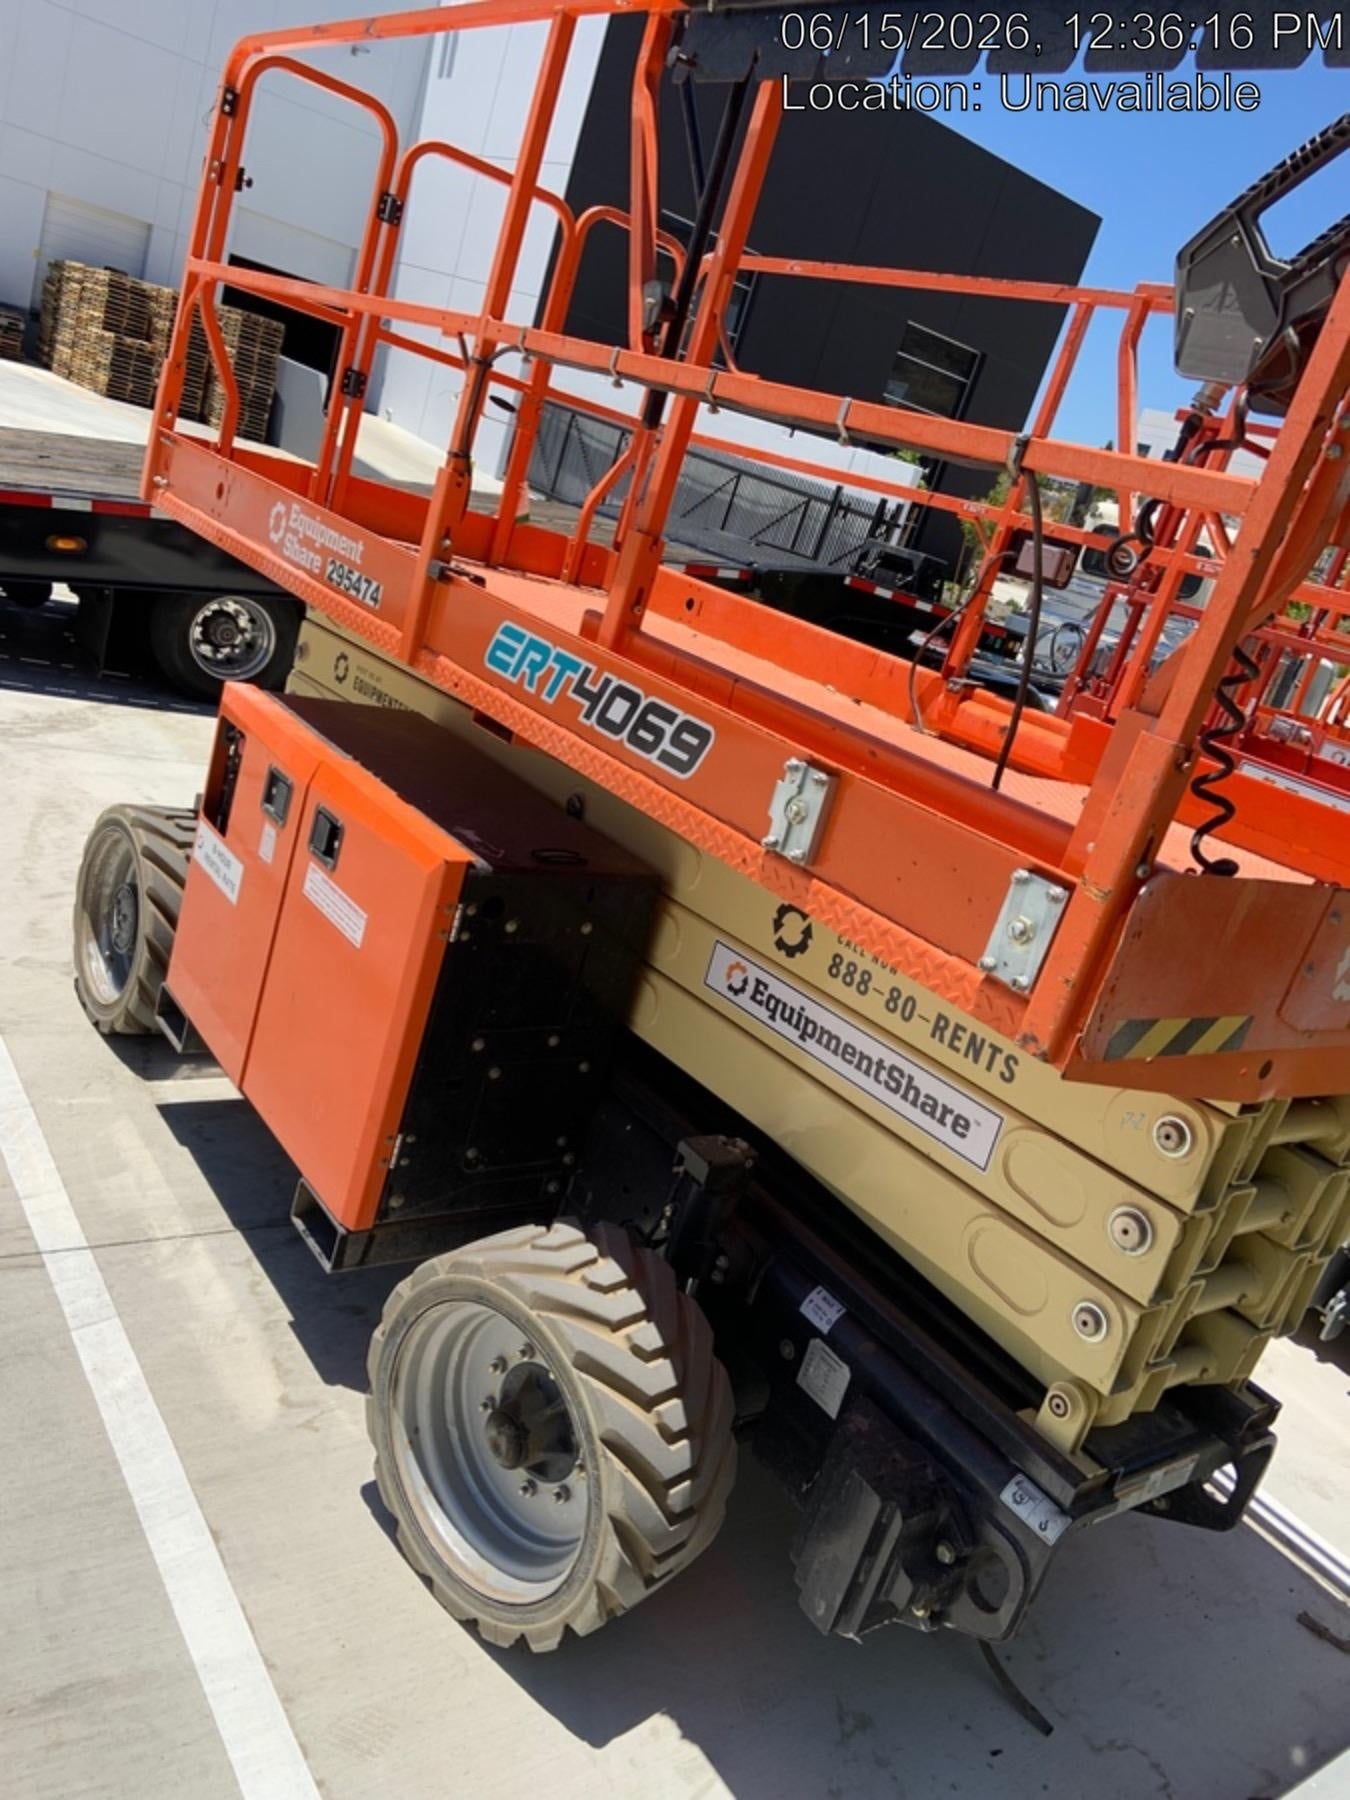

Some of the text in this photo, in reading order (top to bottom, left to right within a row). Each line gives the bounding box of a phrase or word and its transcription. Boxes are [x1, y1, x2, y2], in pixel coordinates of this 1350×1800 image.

[283, 533, 322, 574] Share
[288, 503, 364, 565] Equipment
[327, 559, 381, 607] 295474
[828, 953, 1020, 1085] 888-80-RENTS
[750, 977, 972, 1140] EquipmentShare
